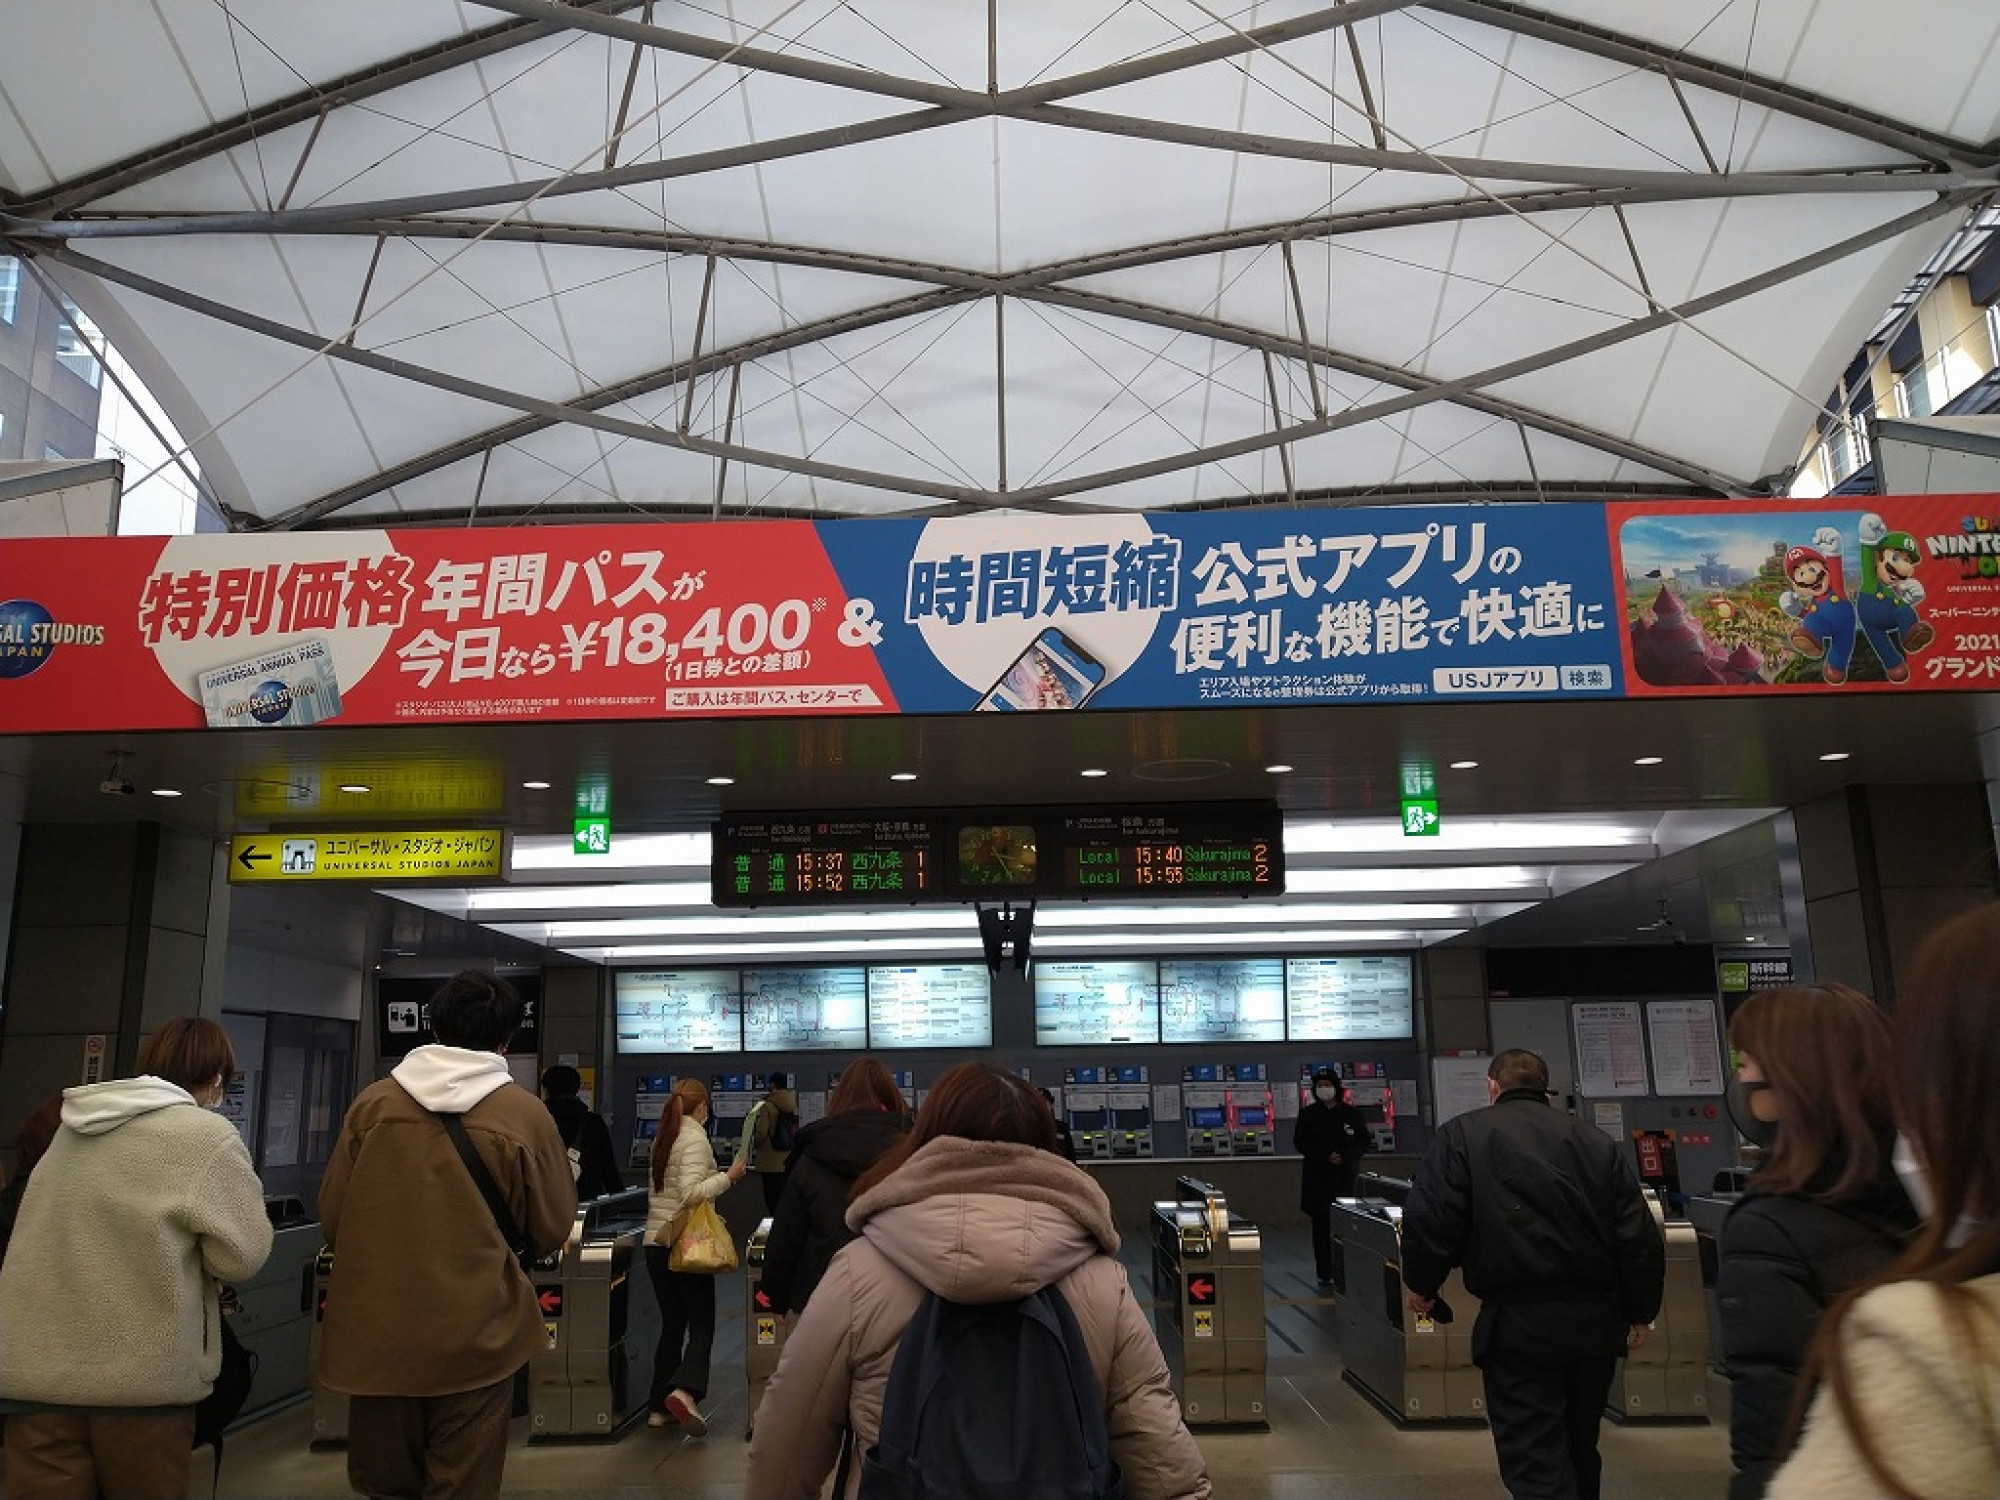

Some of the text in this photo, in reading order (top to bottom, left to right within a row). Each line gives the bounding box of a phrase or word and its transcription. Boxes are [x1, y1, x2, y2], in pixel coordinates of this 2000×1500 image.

[1191, 522, 1522, 605] 公式アプリの
[421, 550, 706, 623] 年間パスが
[905, 535, 1182, 626] 時間短縮
[140, 553, 414, 648] 特別価格
[837, 597, 884, 648] &
[1169, 580, 1606, 675] 便利な機能で快適に
[31, 623, 105, 646] STUDIOS
[206, 645, 325, 690] UNIVERSAL ANNUAL PASS
[1447, 671, 1546, 689] USJアプリ
[671, 688, 862, 707] ご購入は年間パス・センターで
[325, 837, 496, 856] ユニバーサル・スタジオ・ジャパン
[1079, 845, 1269, 864] Local 15:40 Sakurajima 2
[323, 859, 495, 871] UNIVERSAL STUDIOS JAPAN
[797, 853, 843, 870] 15:37
[852, 851, 903, 870] 西九条
[917, 851, 924, 868] 1
[797, 874, 843, 891] 15:52
[852, 872, 904, 891] 西九条
[917, 872, 924, 889] 1
[1079, 865, 1269, 884] Local 15:55 Sakurajima 2
